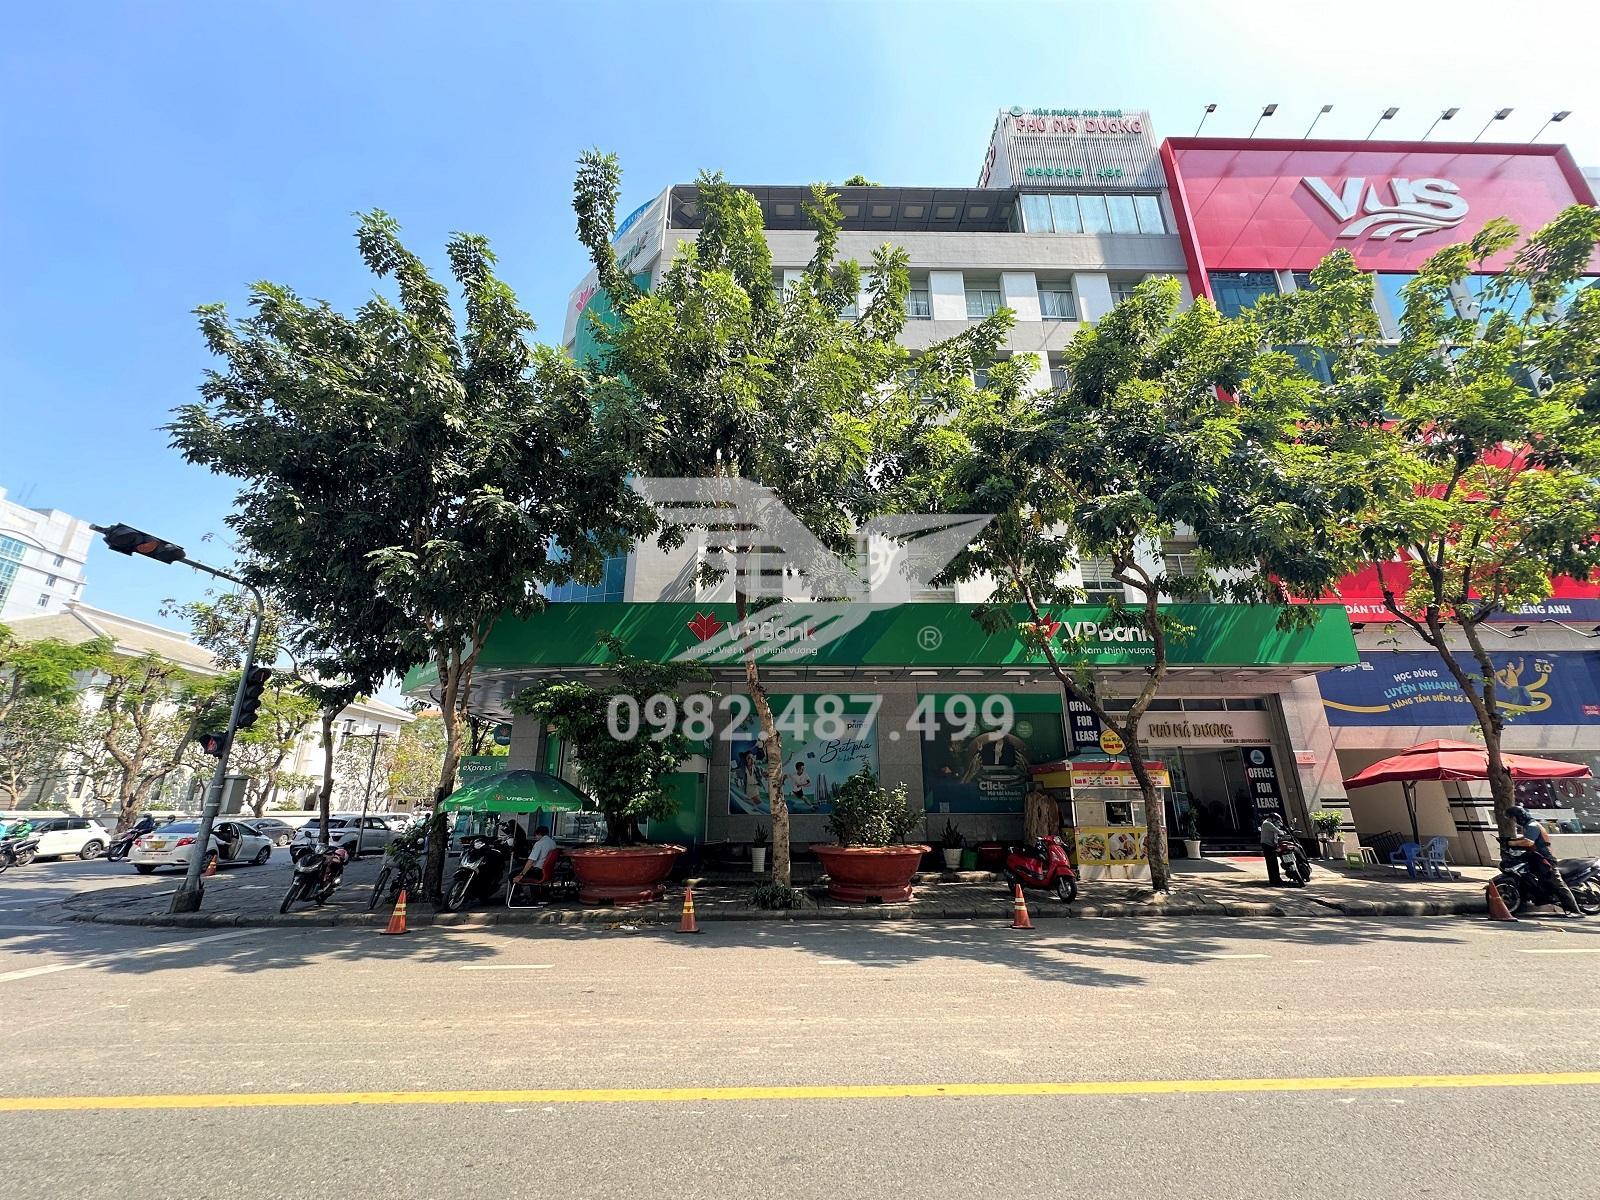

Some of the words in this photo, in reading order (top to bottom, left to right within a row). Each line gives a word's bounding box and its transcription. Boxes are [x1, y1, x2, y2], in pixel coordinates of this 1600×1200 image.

[1299, 176, 1470, 223] VUS
[1547, 604, 1572, 614] ANH
[741, 646, 762, 654] Nm
[1080, 646, 1101, 654] Nam
[1103, 646, 1127, 656] thịnh
[1392, 671, 1412, 683] HỌC
[1413, 668, 1438, 679] ĐÚNG
[1383, 680, 1419, 699] LUYỆN
[1418, 681, 1458, 691] NHANH
[1069, 701, 1092, 712] OFFIC
[1076, 715, 1093, 726] FOR
[847, 722, 869, 731] prim
[1075, 730, 1099, 742] LEASE
[462, 764, 492, 772] eXpress
[1247, 767, 1275, 779] OFFICE
[1256, 782, 1273, 793] FOR
[1256, 797, 1279, 809] LEASE
